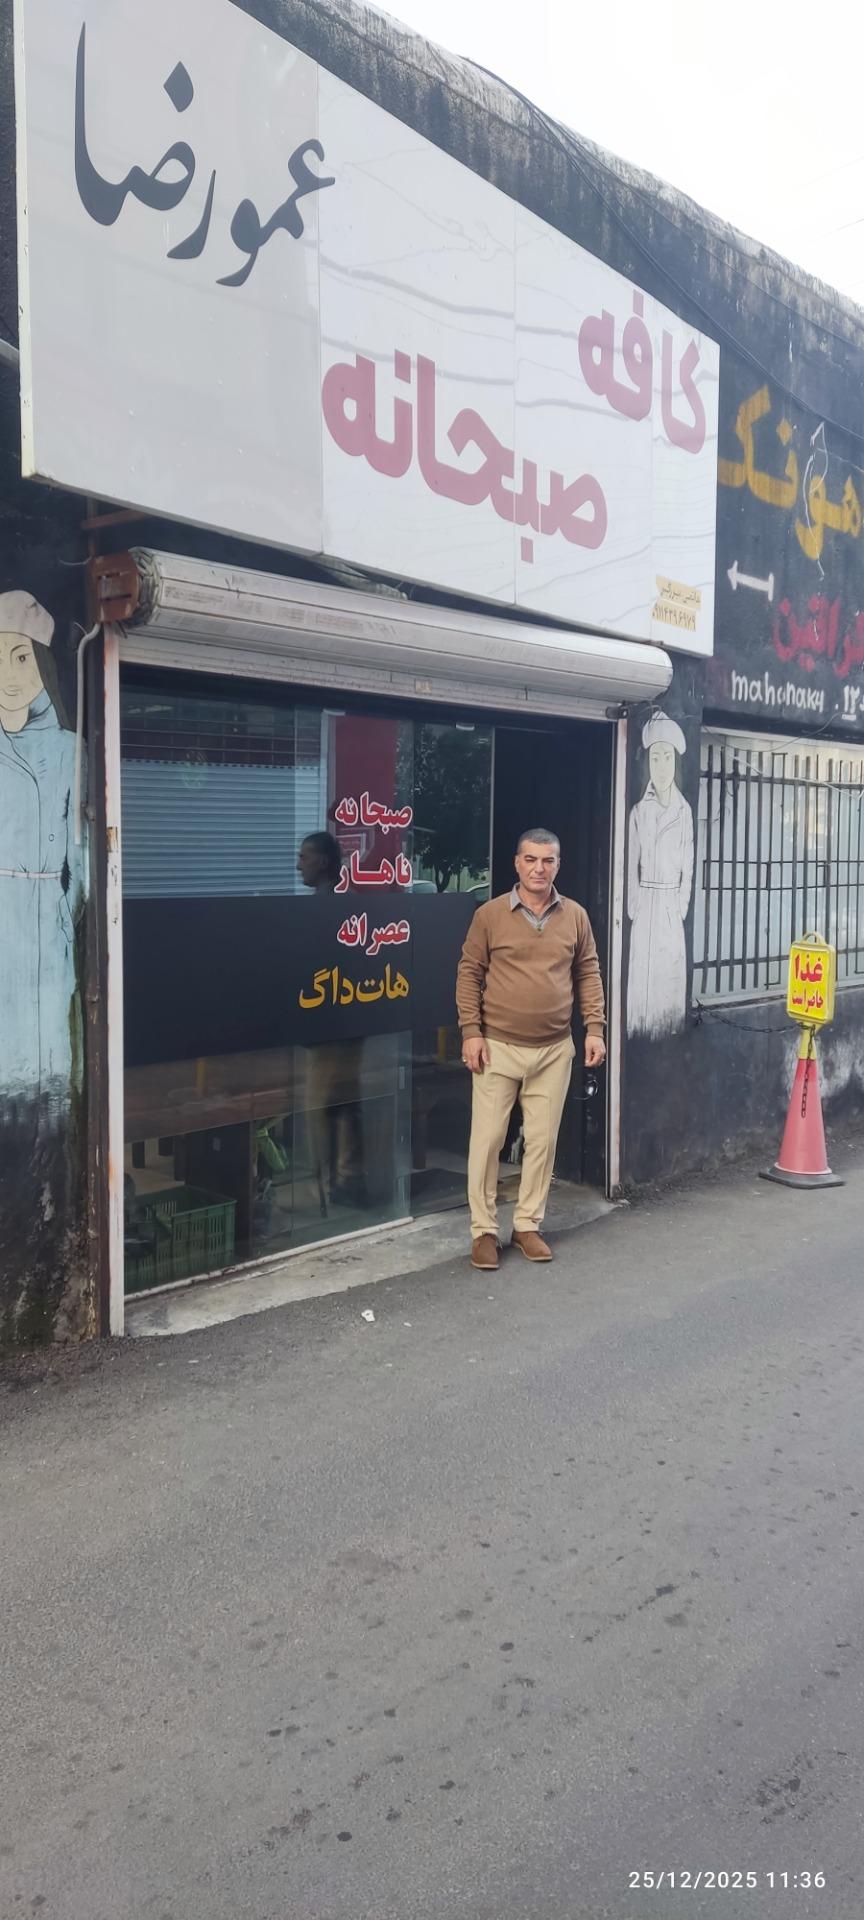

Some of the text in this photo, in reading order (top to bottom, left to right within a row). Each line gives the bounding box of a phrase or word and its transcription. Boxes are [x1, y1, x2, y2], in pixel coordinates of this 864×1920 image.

[578, 289, 706, 455] کافه
[322, 348, 608, 564] صبحانه
[335, 791, 413, 835] صبحانه
[334, 850, 413, 893] ناهار
[337, 912, 411, 955] عصرانه
[795, 954, 823, 982] غذا
